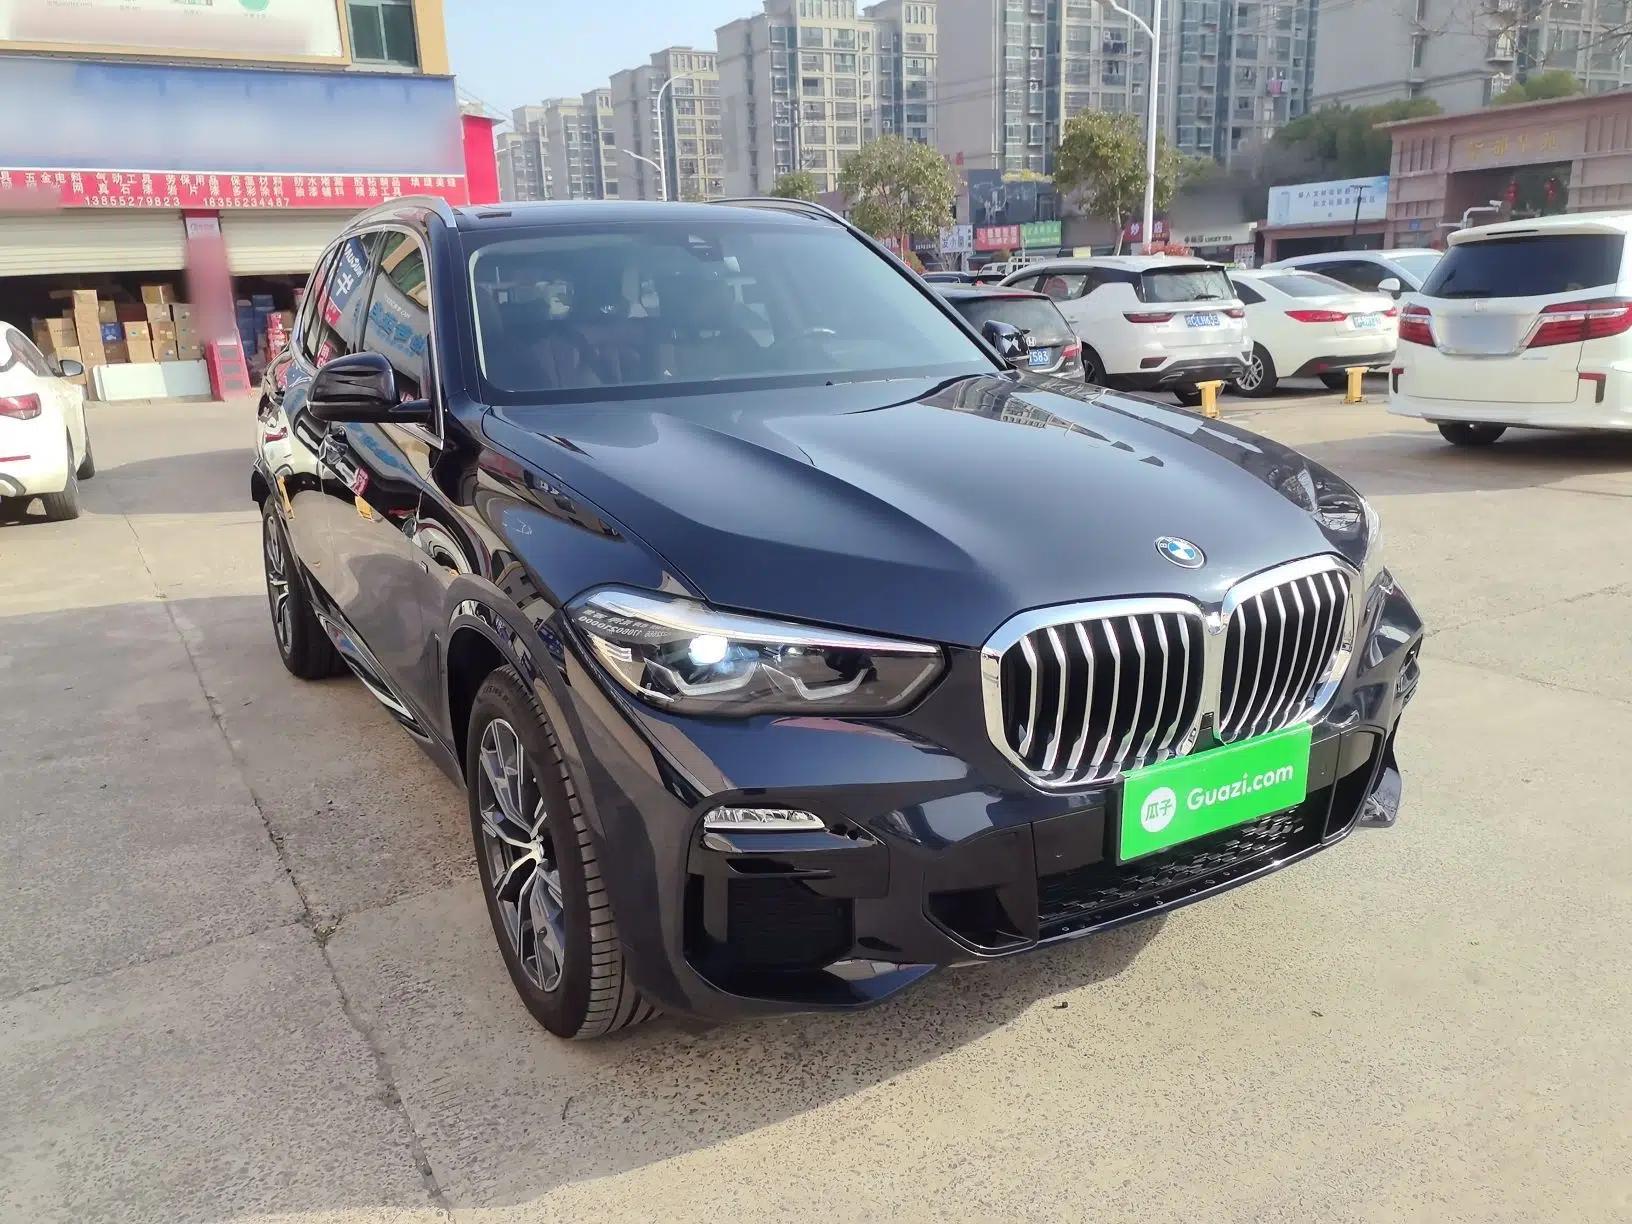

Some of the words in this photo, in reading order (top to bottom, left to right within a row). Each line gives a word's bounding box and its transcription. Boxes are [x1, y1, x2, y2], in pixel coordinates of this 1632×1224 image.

[25, 172, 82, 184] 五金电料
[96, 173, 153, 184] 气动工具
[85, 195, 180, 207] 13855279823
[1186, 764, 1294, 811] Guazi.com
[1145, 798, 1174, 822] 瓜子
